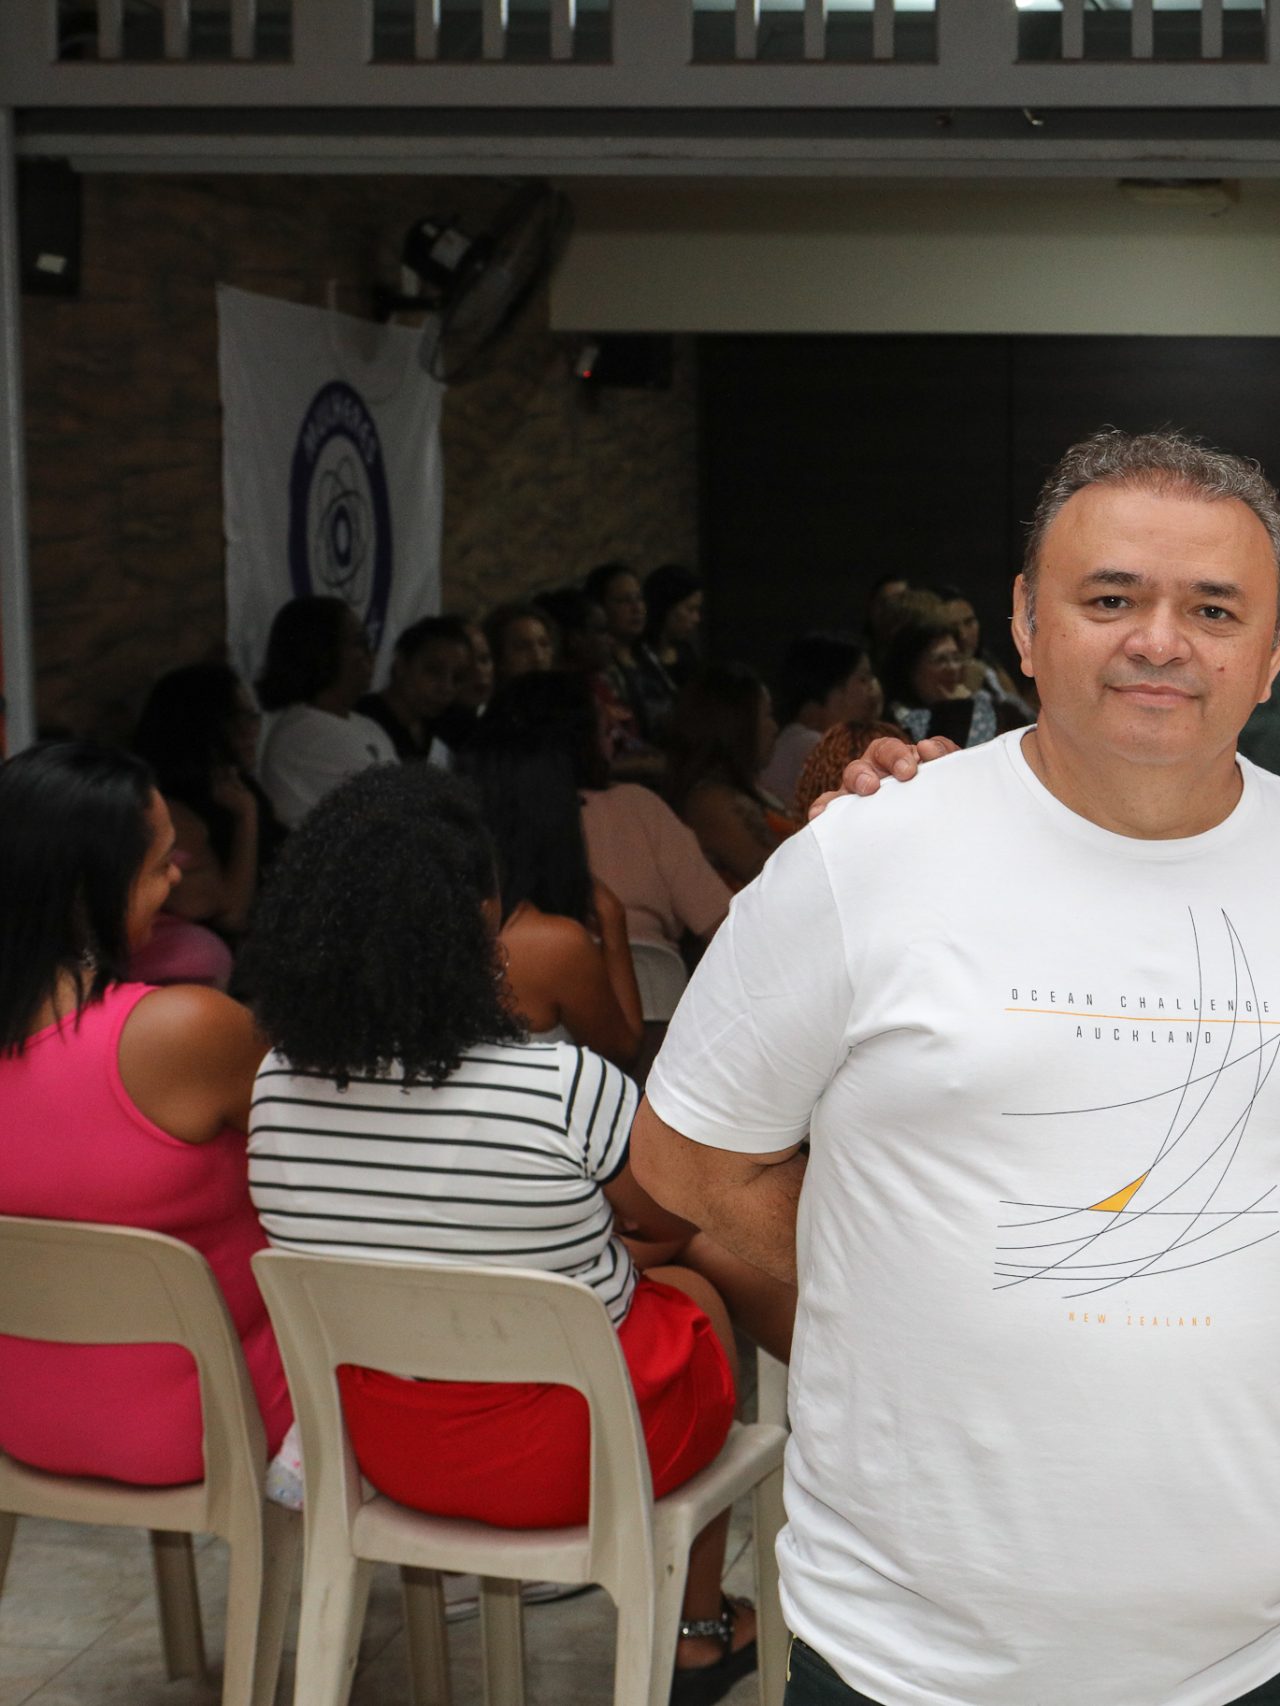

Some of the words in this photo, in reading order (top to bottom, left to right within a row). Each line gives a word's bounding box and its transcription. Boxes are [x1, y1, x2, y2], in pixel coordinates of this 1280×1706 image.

[1012, 988, 1094, 1006] OCEAN
[1120, 996, 1270, 1013] CHALLENGE
[1076, 1025, 1212, 1044] AUCKLAND
[1069, 1313, 1106, 1323] NEW
[1127, 1315, 1212, 1327] ZEALAND
